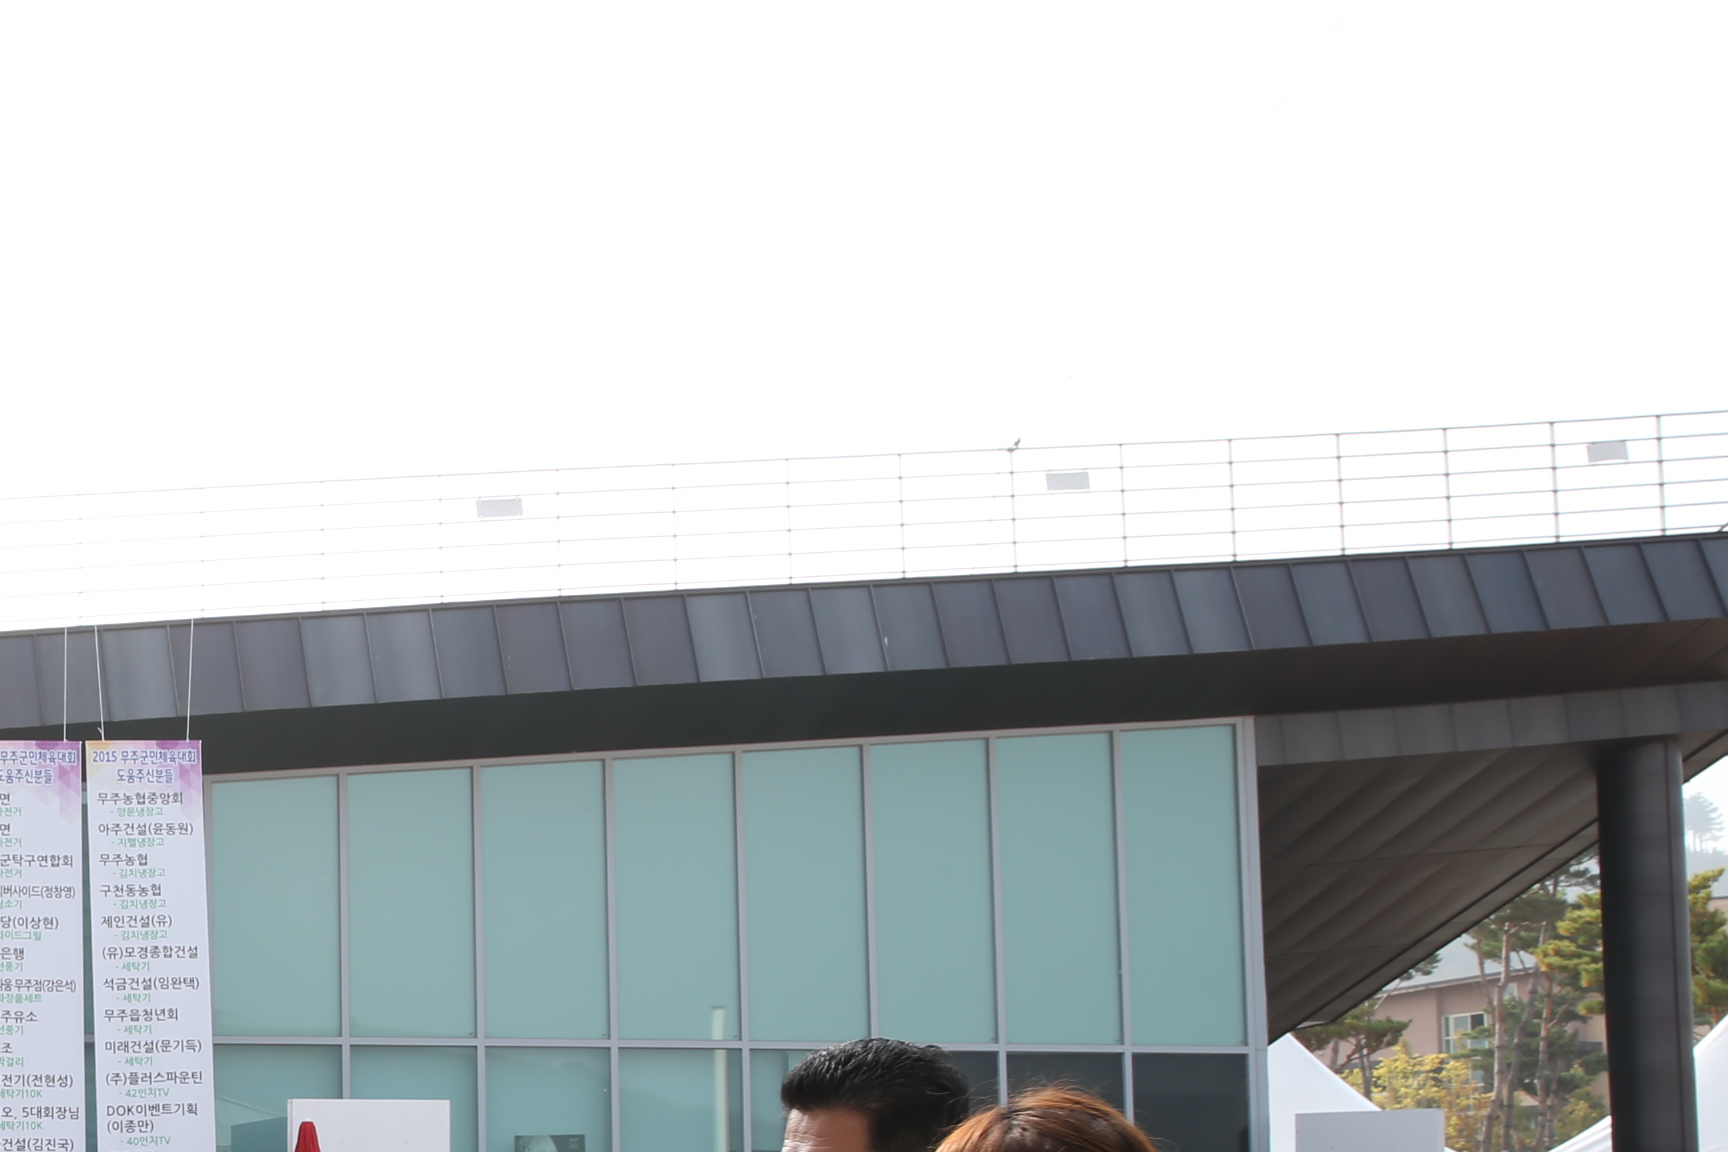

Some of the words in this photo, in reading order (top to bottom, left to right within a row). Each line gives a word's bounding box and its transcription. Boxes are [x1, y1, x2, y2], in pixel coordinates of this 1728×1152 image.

[0, 751, 76, 765] 무주군민체육대회
[93, 751, 117, 762] 2015
[121, 750, 196, 765] 무주군민체육대회
[117, 769, 174, 784] 도움주신분들
[97, 792, 183, 806] 무주농협중앙회
[117, 807, 164, 817] 양문냉장고
[98, 822, 193, 836] 아주건설(윤동원)
[99, 854, 148, 866] 무주농협
[119, 868, 166, 878] 김치냉장고
[100, 884, 161, 897] 구천동농협
[120, 900, 167, 910] 김치냉장고
[101, 915, 172, 928] 제인건설(유)
[121, 930, 168, 940] 김치냉장고
[102, 946, 198, 960] (유)모경종합건설
[122, 962, 150, 972] 세탁기
[14, 978, 76, 992] 무주점(강은석)
[103, 977, 200, 991] 석금건설(임완택)
[123, 993, 150, 1003] 세탁기
[104, 1008, 178, 1022] 무주읍청년회
[124, 1024, 152, 1034] 세탁기
[105, 1040, 202, 1054] 미래건설(문기득)
[125, 1056, 153, 1066] 세탁기
[106, 1071, 203, 1086] (주)플러스파운틴
[125, 1088, 170, 1098] 42인치TV
[22, 1106, 79, 1120] 5대회장님
[106, 1103, 198, 1117] DOK이벤트기획
[107, 1120, 154, 1134] (이종만)
[127, 1136, 171, 1146] 40인치TV
